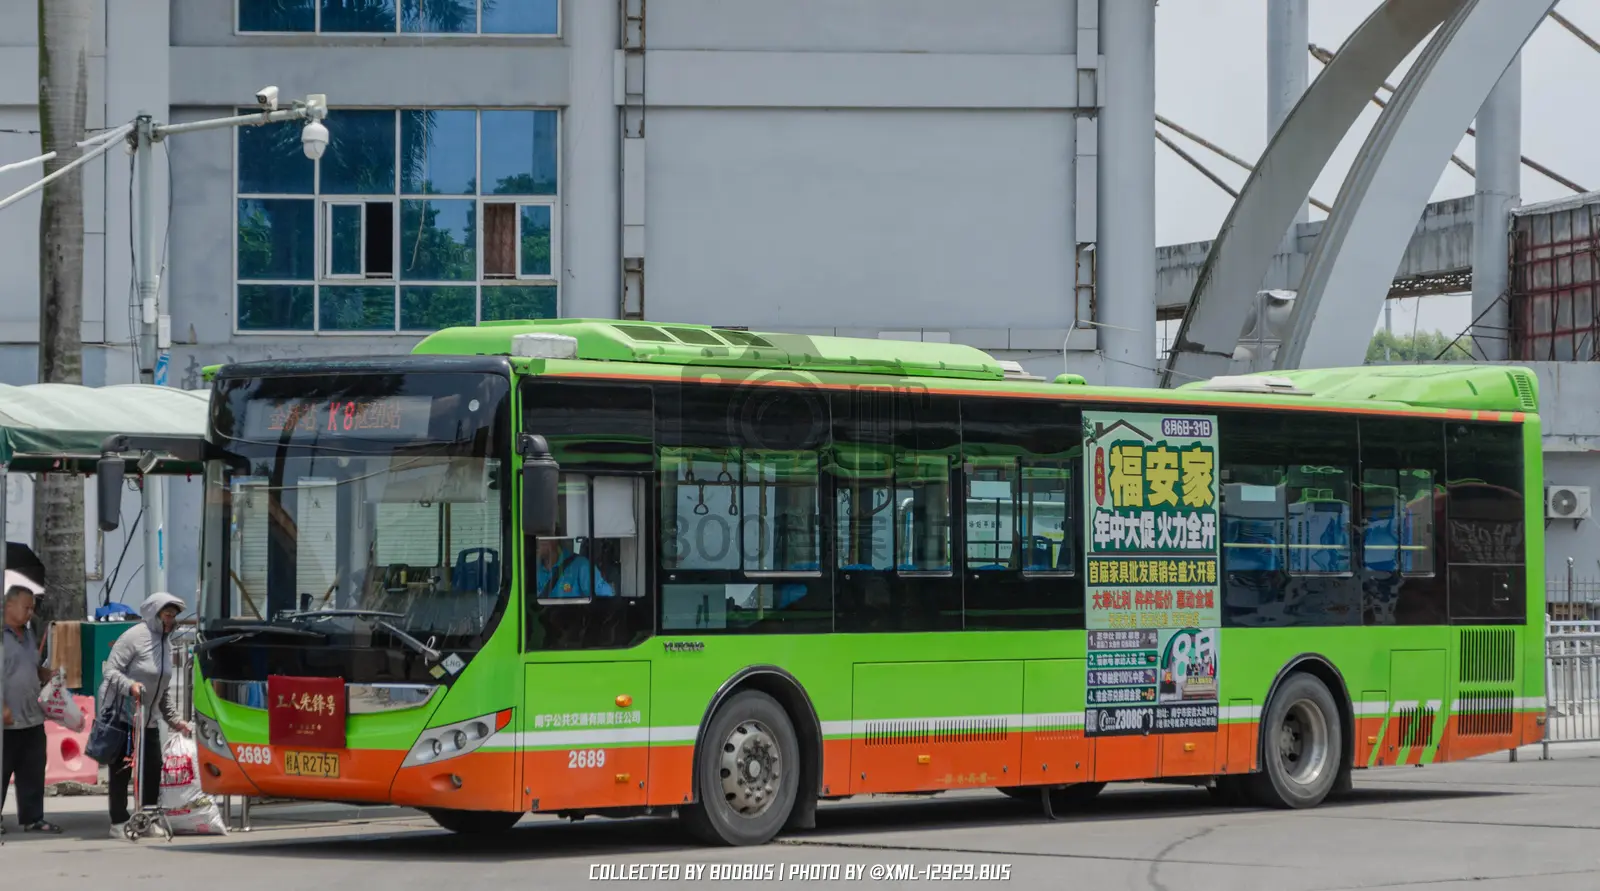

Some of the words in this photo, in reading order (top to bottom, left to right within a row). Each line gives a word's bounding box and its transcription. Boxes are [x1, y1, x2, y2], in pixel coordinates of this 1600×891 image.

[1164, 419, 1211, 436] 8月6日-31日
[1109, 445, 1214, 508] 福安家
[1094, 510, 1155, 549] 年中大促
[1157, 511, 1216, 549] 火力全开
[1089, 560, 1216, 583] 首届家具批发展销会盛大开幕
[276, 692, 336, 717] 工人先锋号
[534, 710, 641, 728] 南宁公共交通有限责任公司
[237, 745, 271, 764] 2689
[568, 749, 605, 769] 2689
